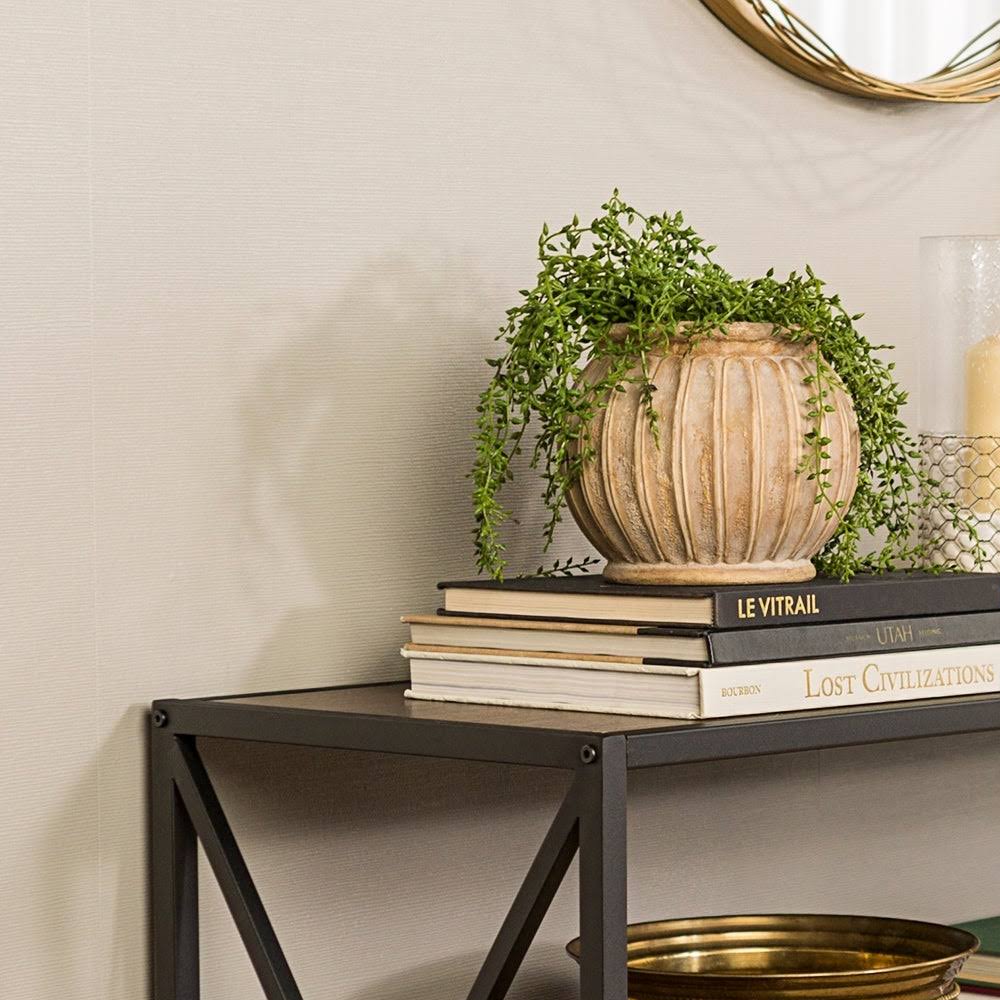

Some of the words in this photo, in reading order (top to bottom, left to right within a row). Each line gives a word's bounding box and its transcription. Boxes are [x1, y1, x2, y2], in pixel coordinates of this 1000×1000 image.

[737, 599, 755, 619] LE
[758, 594, 819, 616] VITRAIL
[876, 624, 913, 645] UTAH
[721, 684, 762, 698] BOURBON
